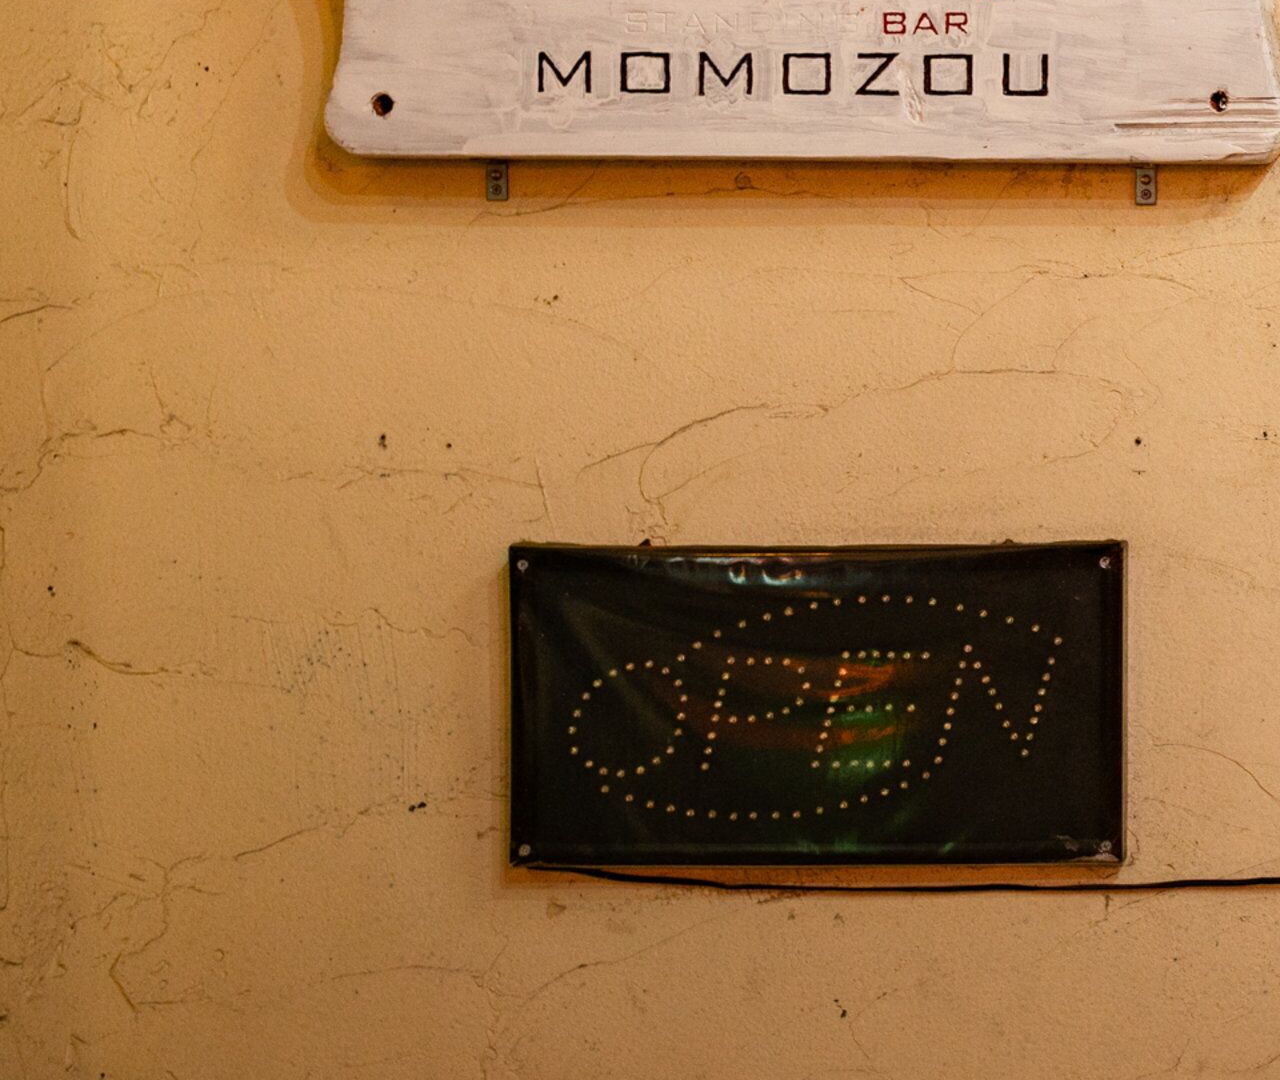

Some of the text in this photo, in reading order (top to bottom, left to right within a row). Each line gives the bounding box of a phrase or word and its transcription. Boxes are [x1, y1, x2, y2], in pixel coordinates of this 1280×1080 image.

[882, 11, 969, 35] BAR
[537, 51, 1049, 96] MOMOZOU
[568, 638, 1064, 777] OPEN
